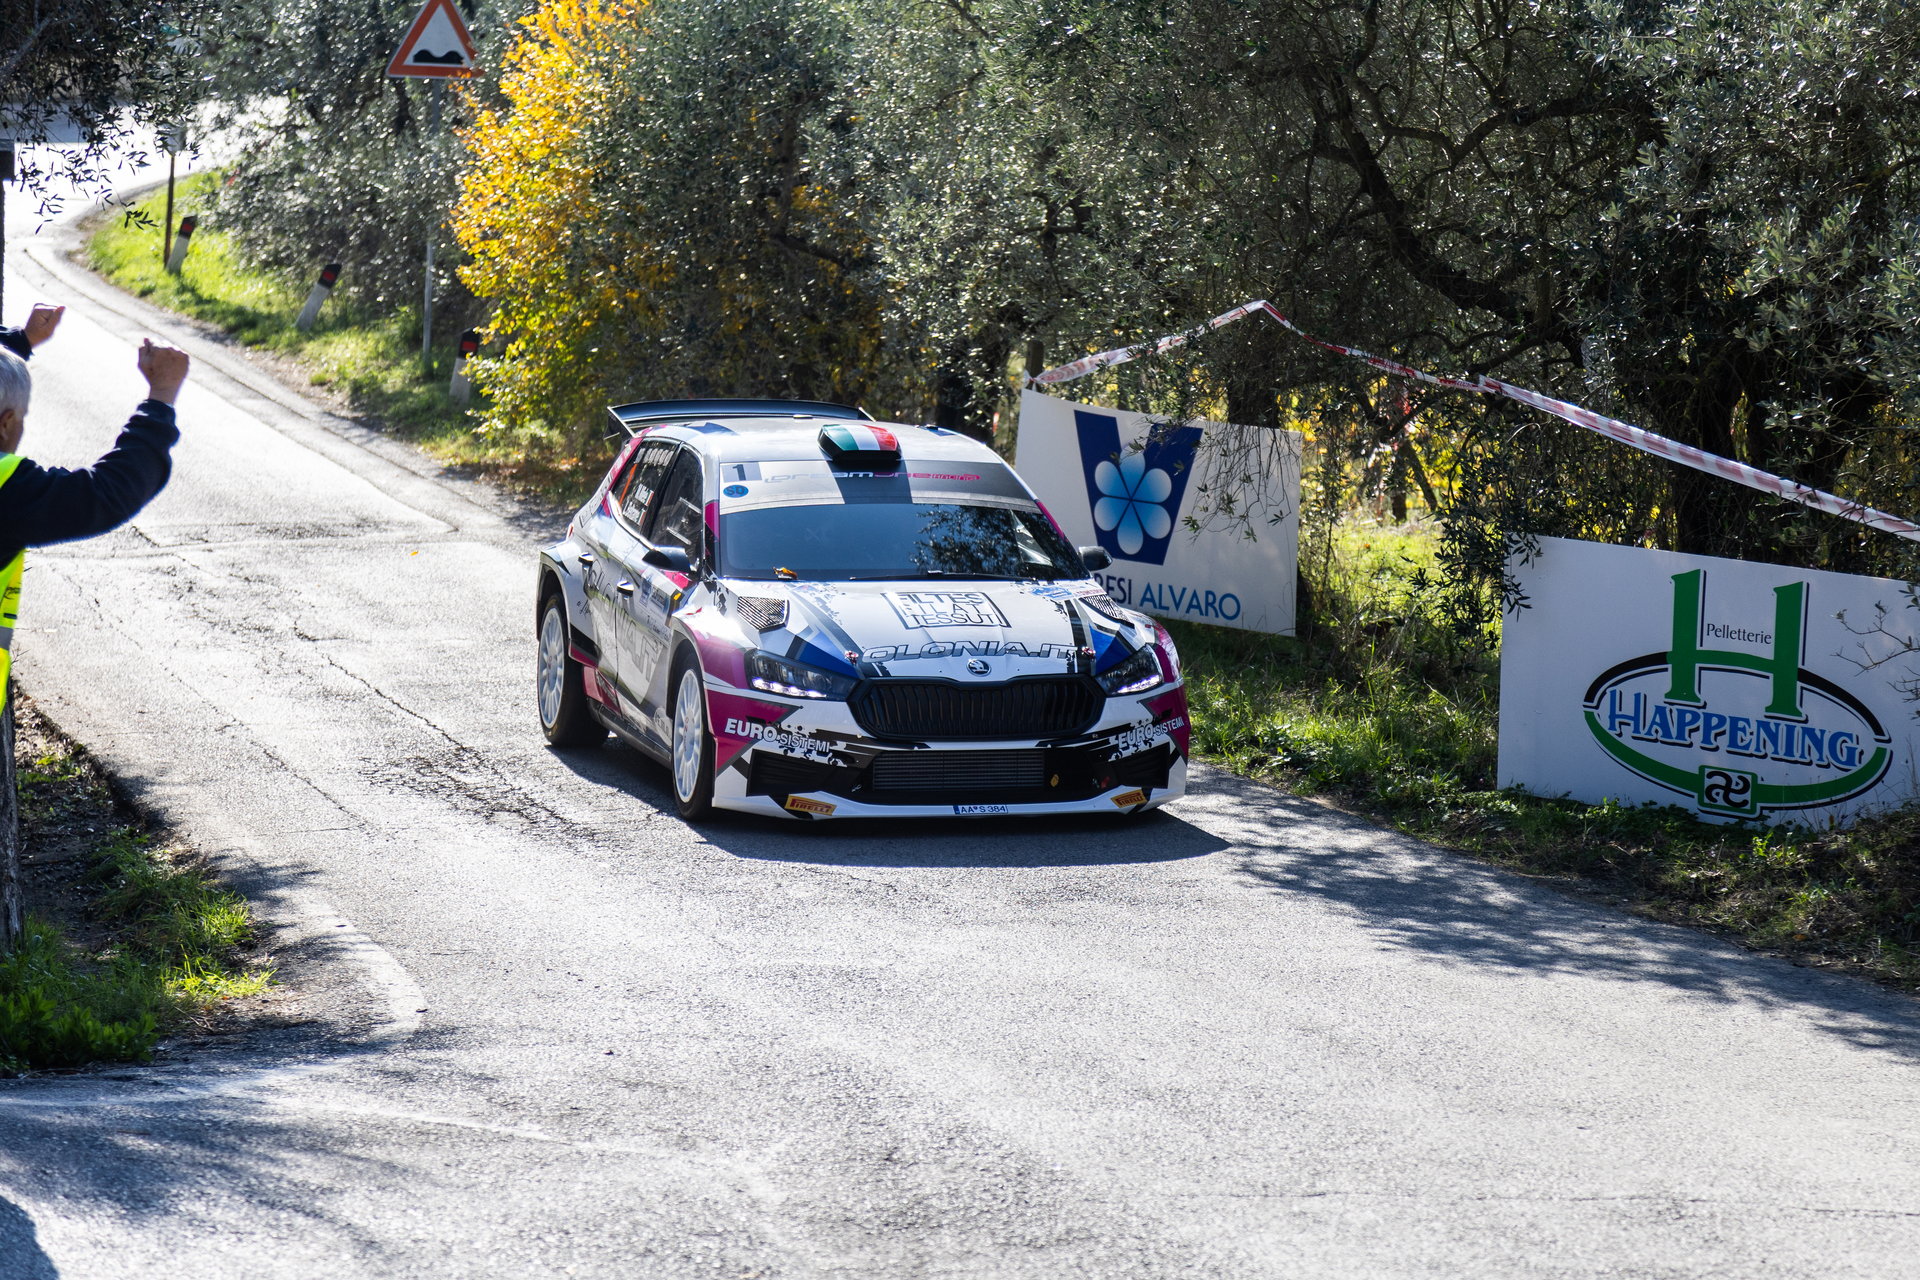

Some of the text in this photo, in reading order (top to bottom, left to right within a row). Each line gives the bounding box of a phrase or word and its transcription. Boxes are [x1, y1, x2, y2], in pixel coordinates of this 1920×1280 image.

[732, 464, 747, 481] 1
[1139, 581, 1241, 621] ALVARO
[1706, 623, 1772, 645] Pelletterie
[1608, 688, 1864, 772] HAPPENING
